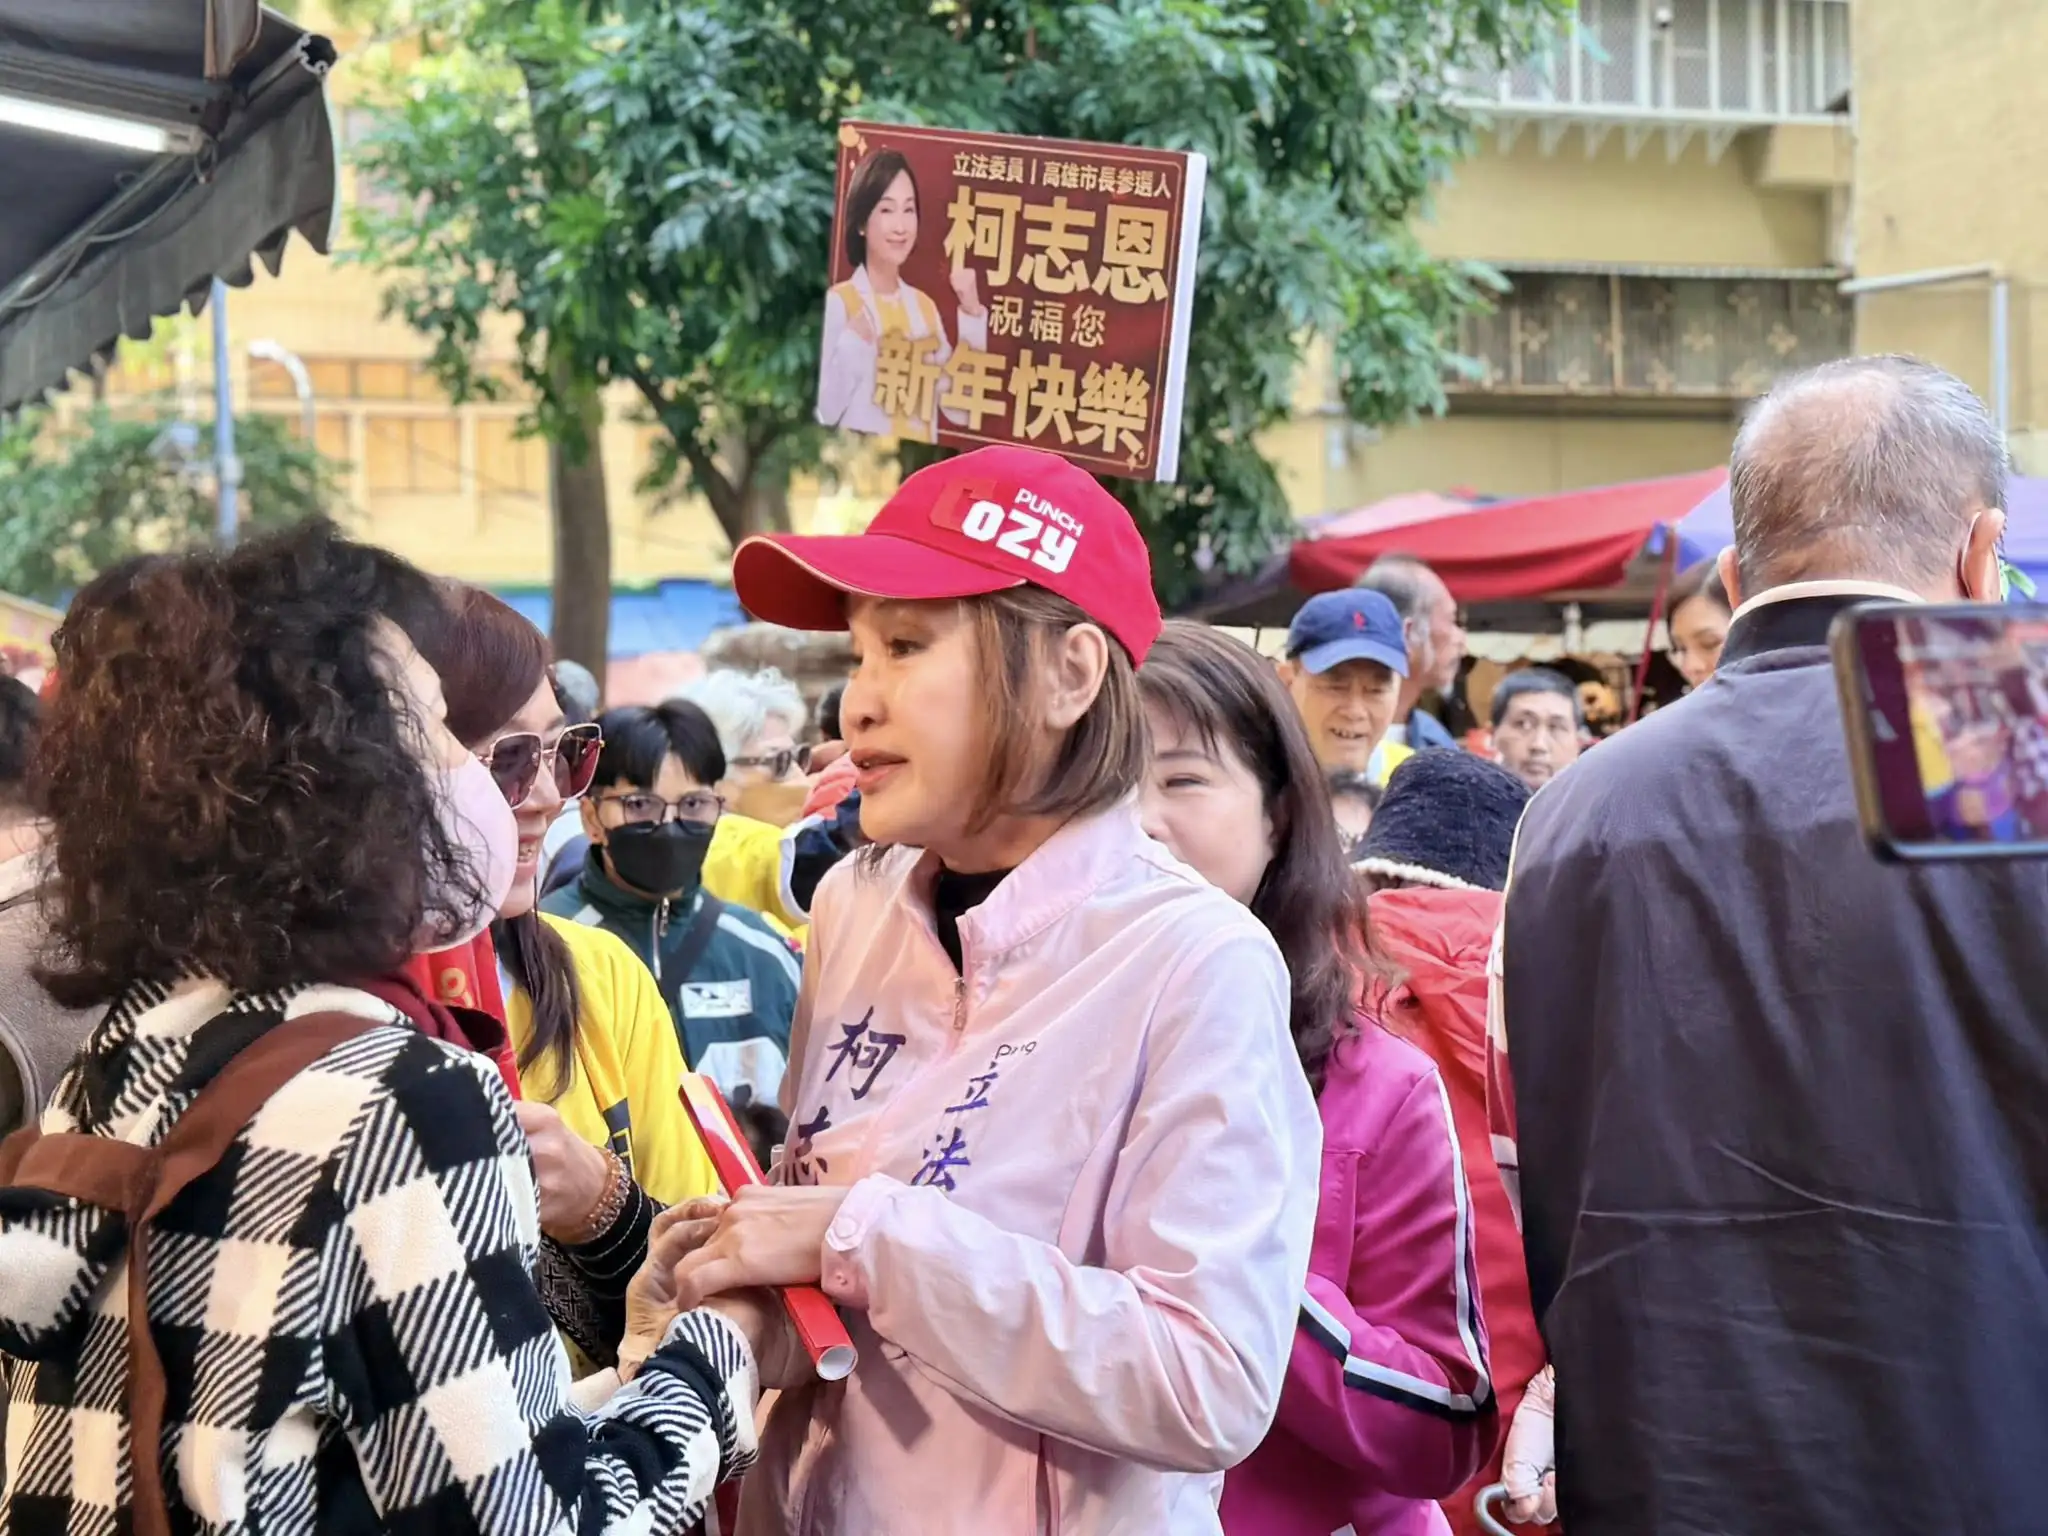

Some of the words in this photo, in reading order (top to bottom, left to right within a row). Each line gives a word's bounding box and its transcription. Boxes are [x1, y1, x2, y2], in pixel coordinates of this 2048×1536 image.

[953, 152, 1024, 184] 立法委員
[944, 185, 1168, 304] 柯志恩
[989, 294, 1106, 348] 祝福您
[874, 326, 1150, 456] 新年快樂
[1014, 487, 1084, 537] PUNCH
